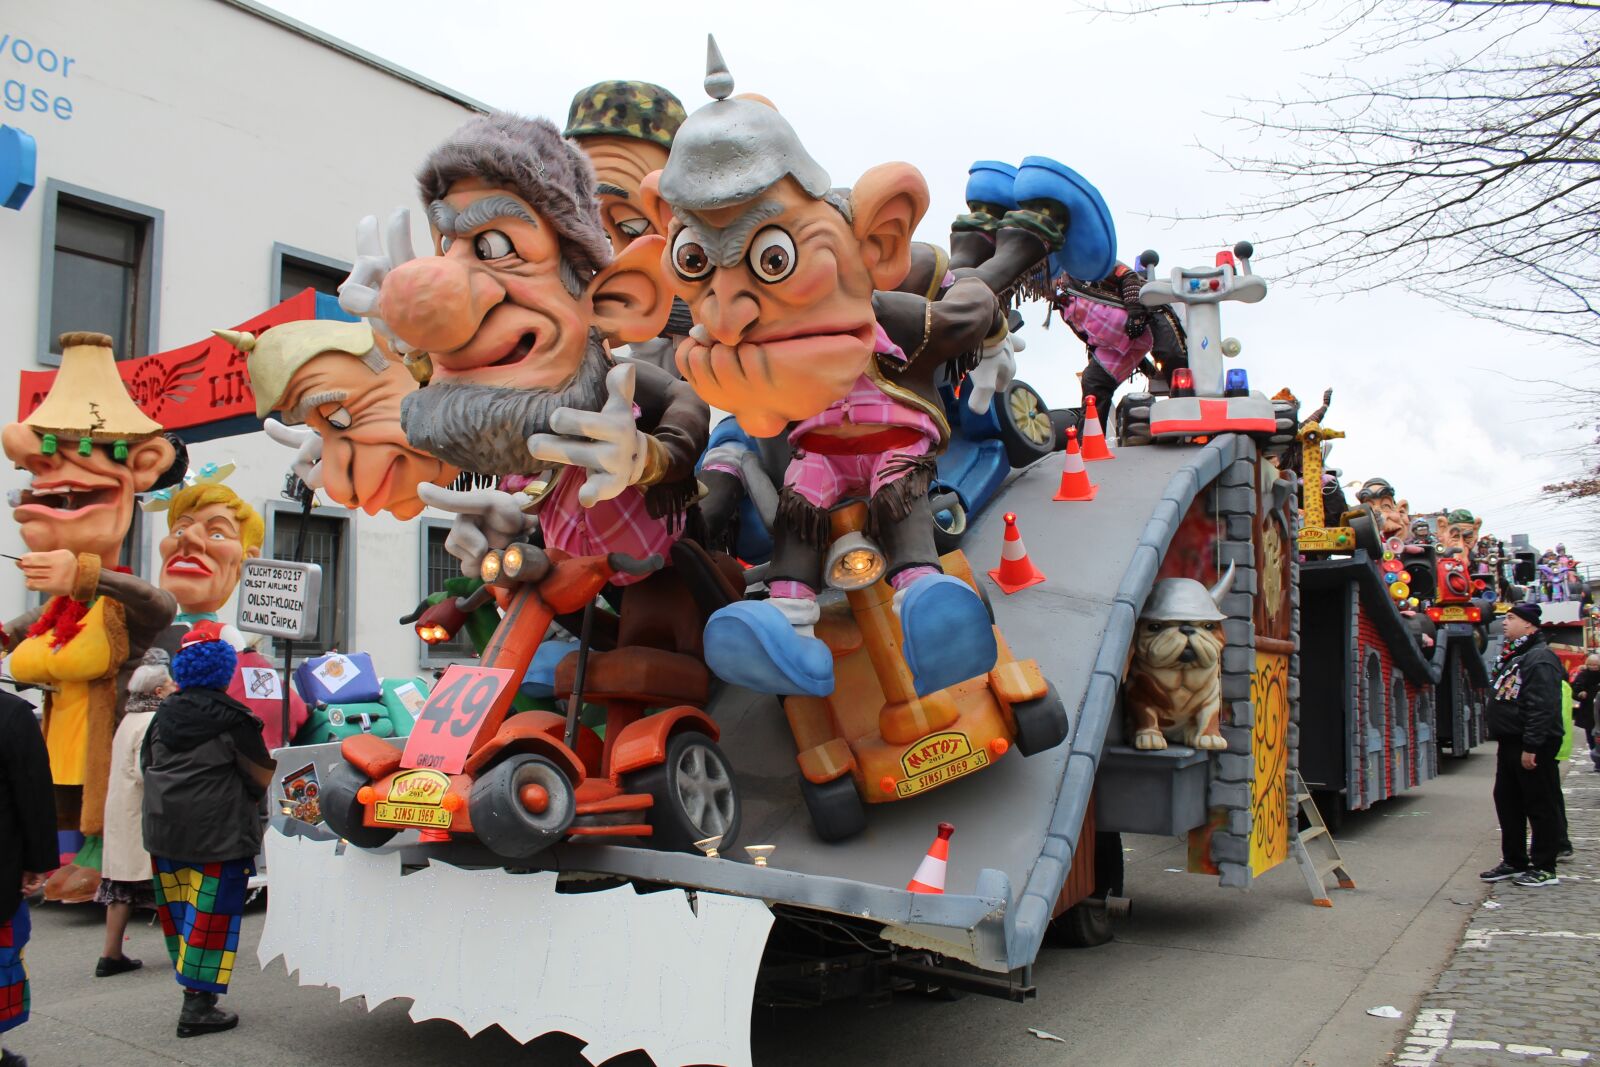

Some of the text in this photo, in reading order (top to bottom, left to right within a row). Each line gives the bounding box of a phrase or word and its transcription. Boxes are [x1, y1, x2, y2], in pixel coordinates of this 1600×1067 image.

[209, 370, 254, 408] LIN
[249, 568, 271, 577] VLICHT
[245, 579, 297, 592] OILSJT AIRLINES
[421, 673, 499, 737] 49
[416, 753, 445, 768] GROOT
[907, 738, 963, 769] MATOT
[946, 760, 968, 777] 1969
[396, 777, 443, 797] MATOT
[408, 790, 424, 798] 2017
[418, 809, 435, 822] 1969
